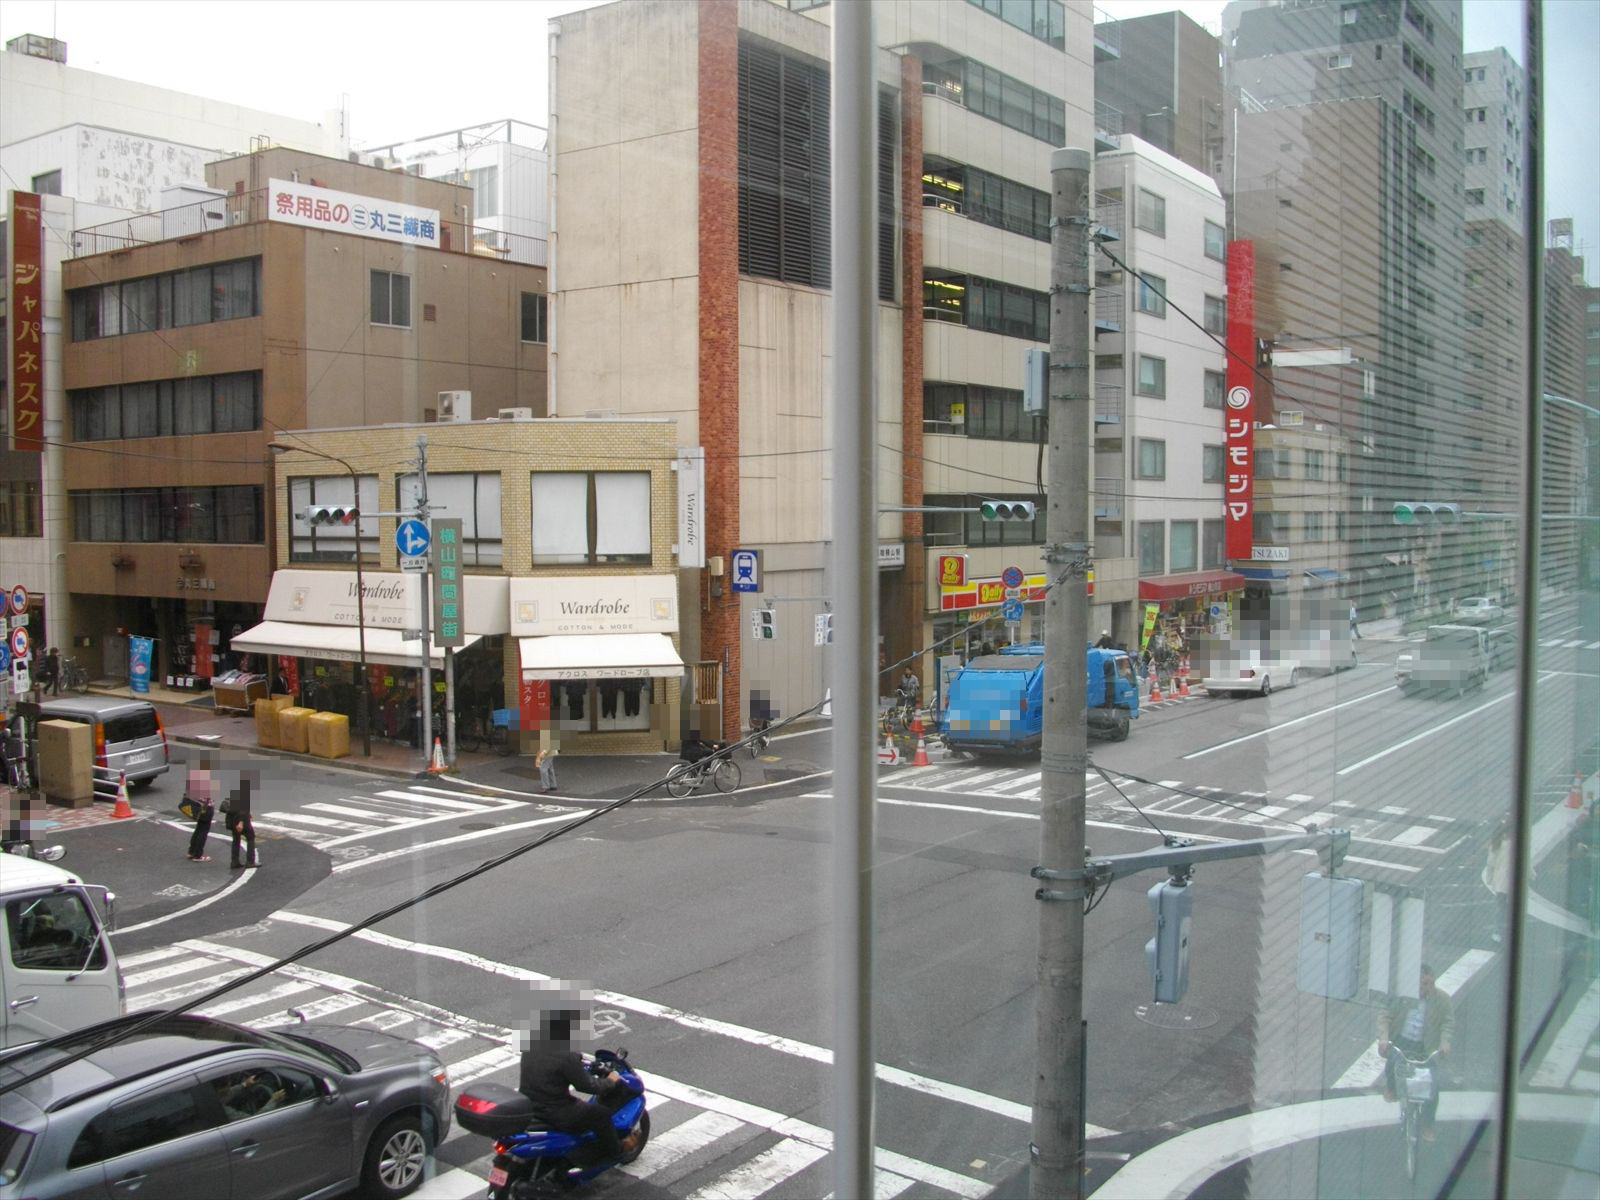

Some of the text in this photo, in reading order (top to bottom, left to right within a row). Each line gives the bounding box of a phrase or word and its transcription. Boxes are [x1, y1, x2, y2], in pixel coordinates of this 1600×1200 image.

[15, 263, 40, 431] ジャパネスク
[1229, 418, 1248, 521] シモジマ
[687, 493, 698, 546] Wardrobe
[348, 580, 404, 600] Wardrobe
[560, 598, 630, 615] Wardrobe
[334, 613, 365, 622] COTTO
[381, 616, 403, 624] MODE
[557, 669, 651, 679] アクロス ワードローブ店
